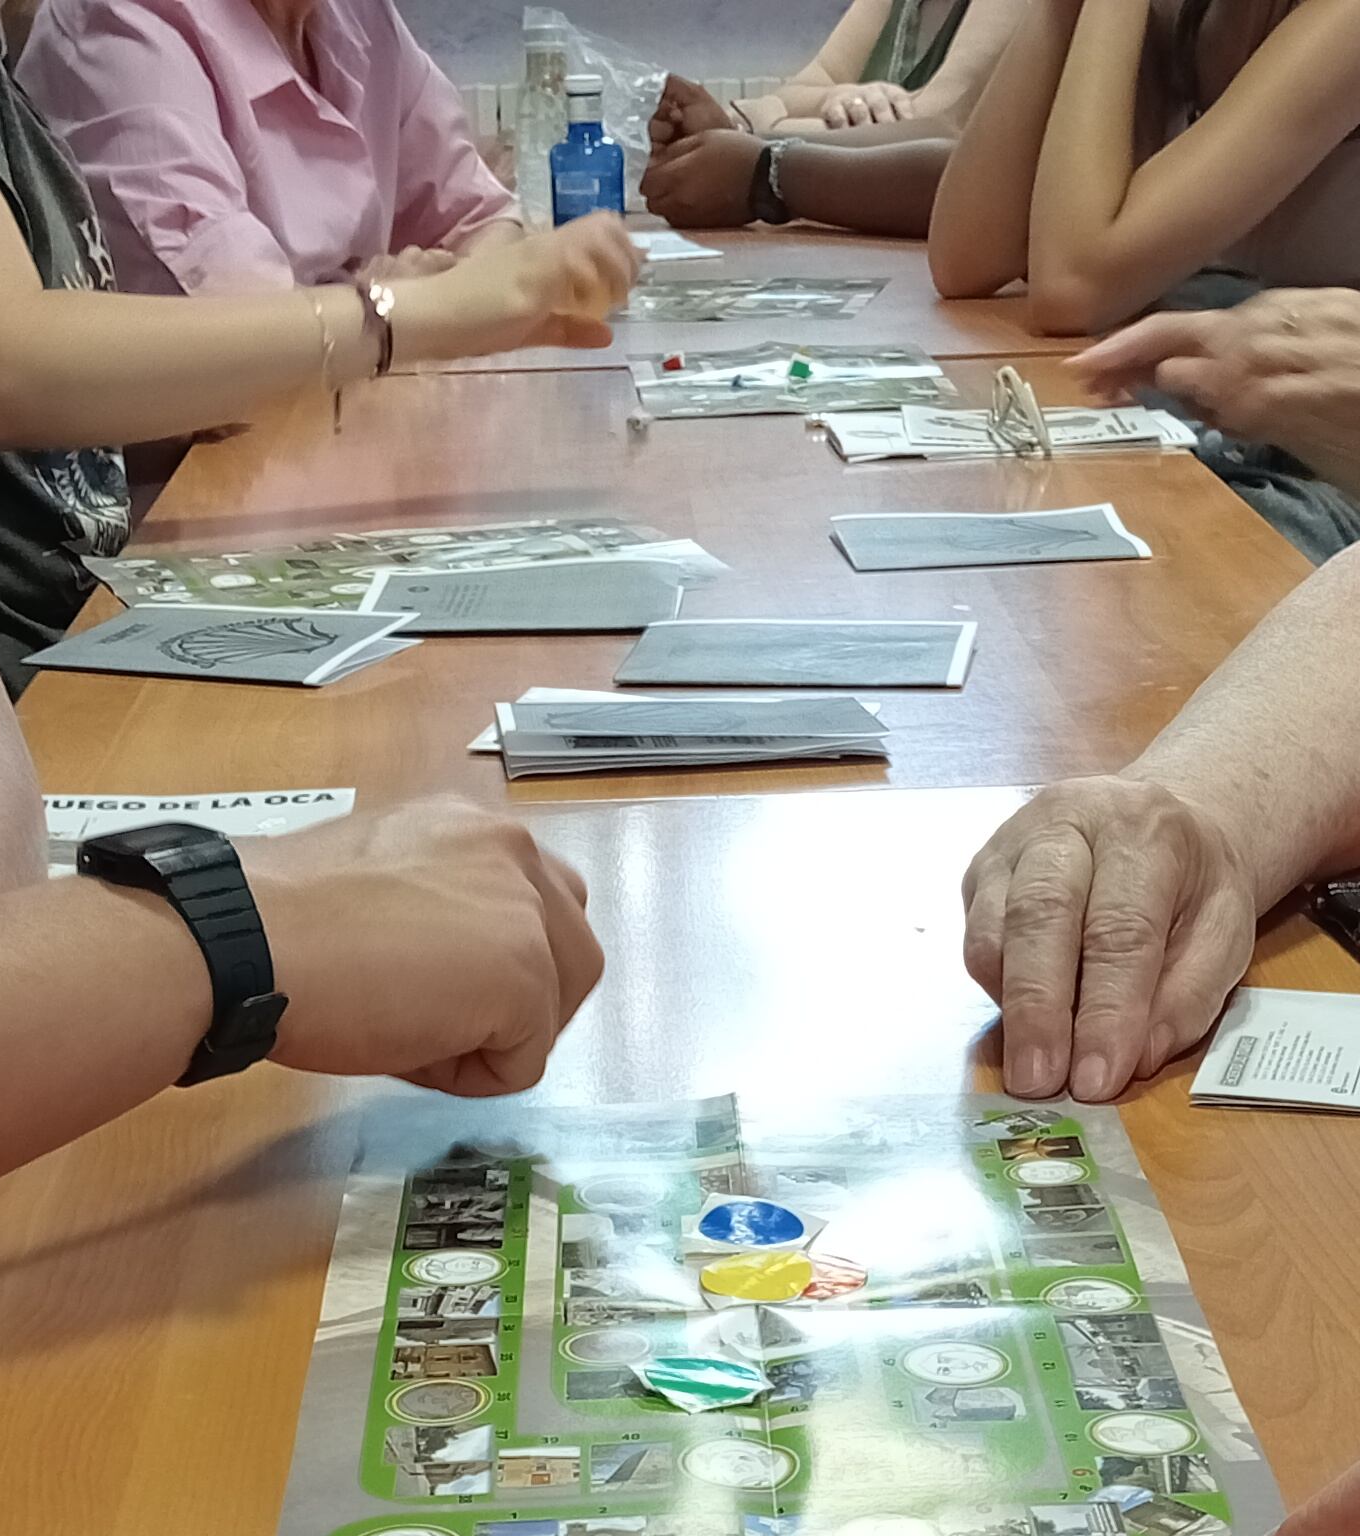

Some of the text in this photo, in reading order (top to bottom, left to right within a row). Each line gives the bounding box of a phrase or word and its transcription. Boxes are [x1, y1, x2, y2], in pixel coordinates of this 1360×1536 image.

[44, 792, 336, 811] UEGO DE LA OCA
